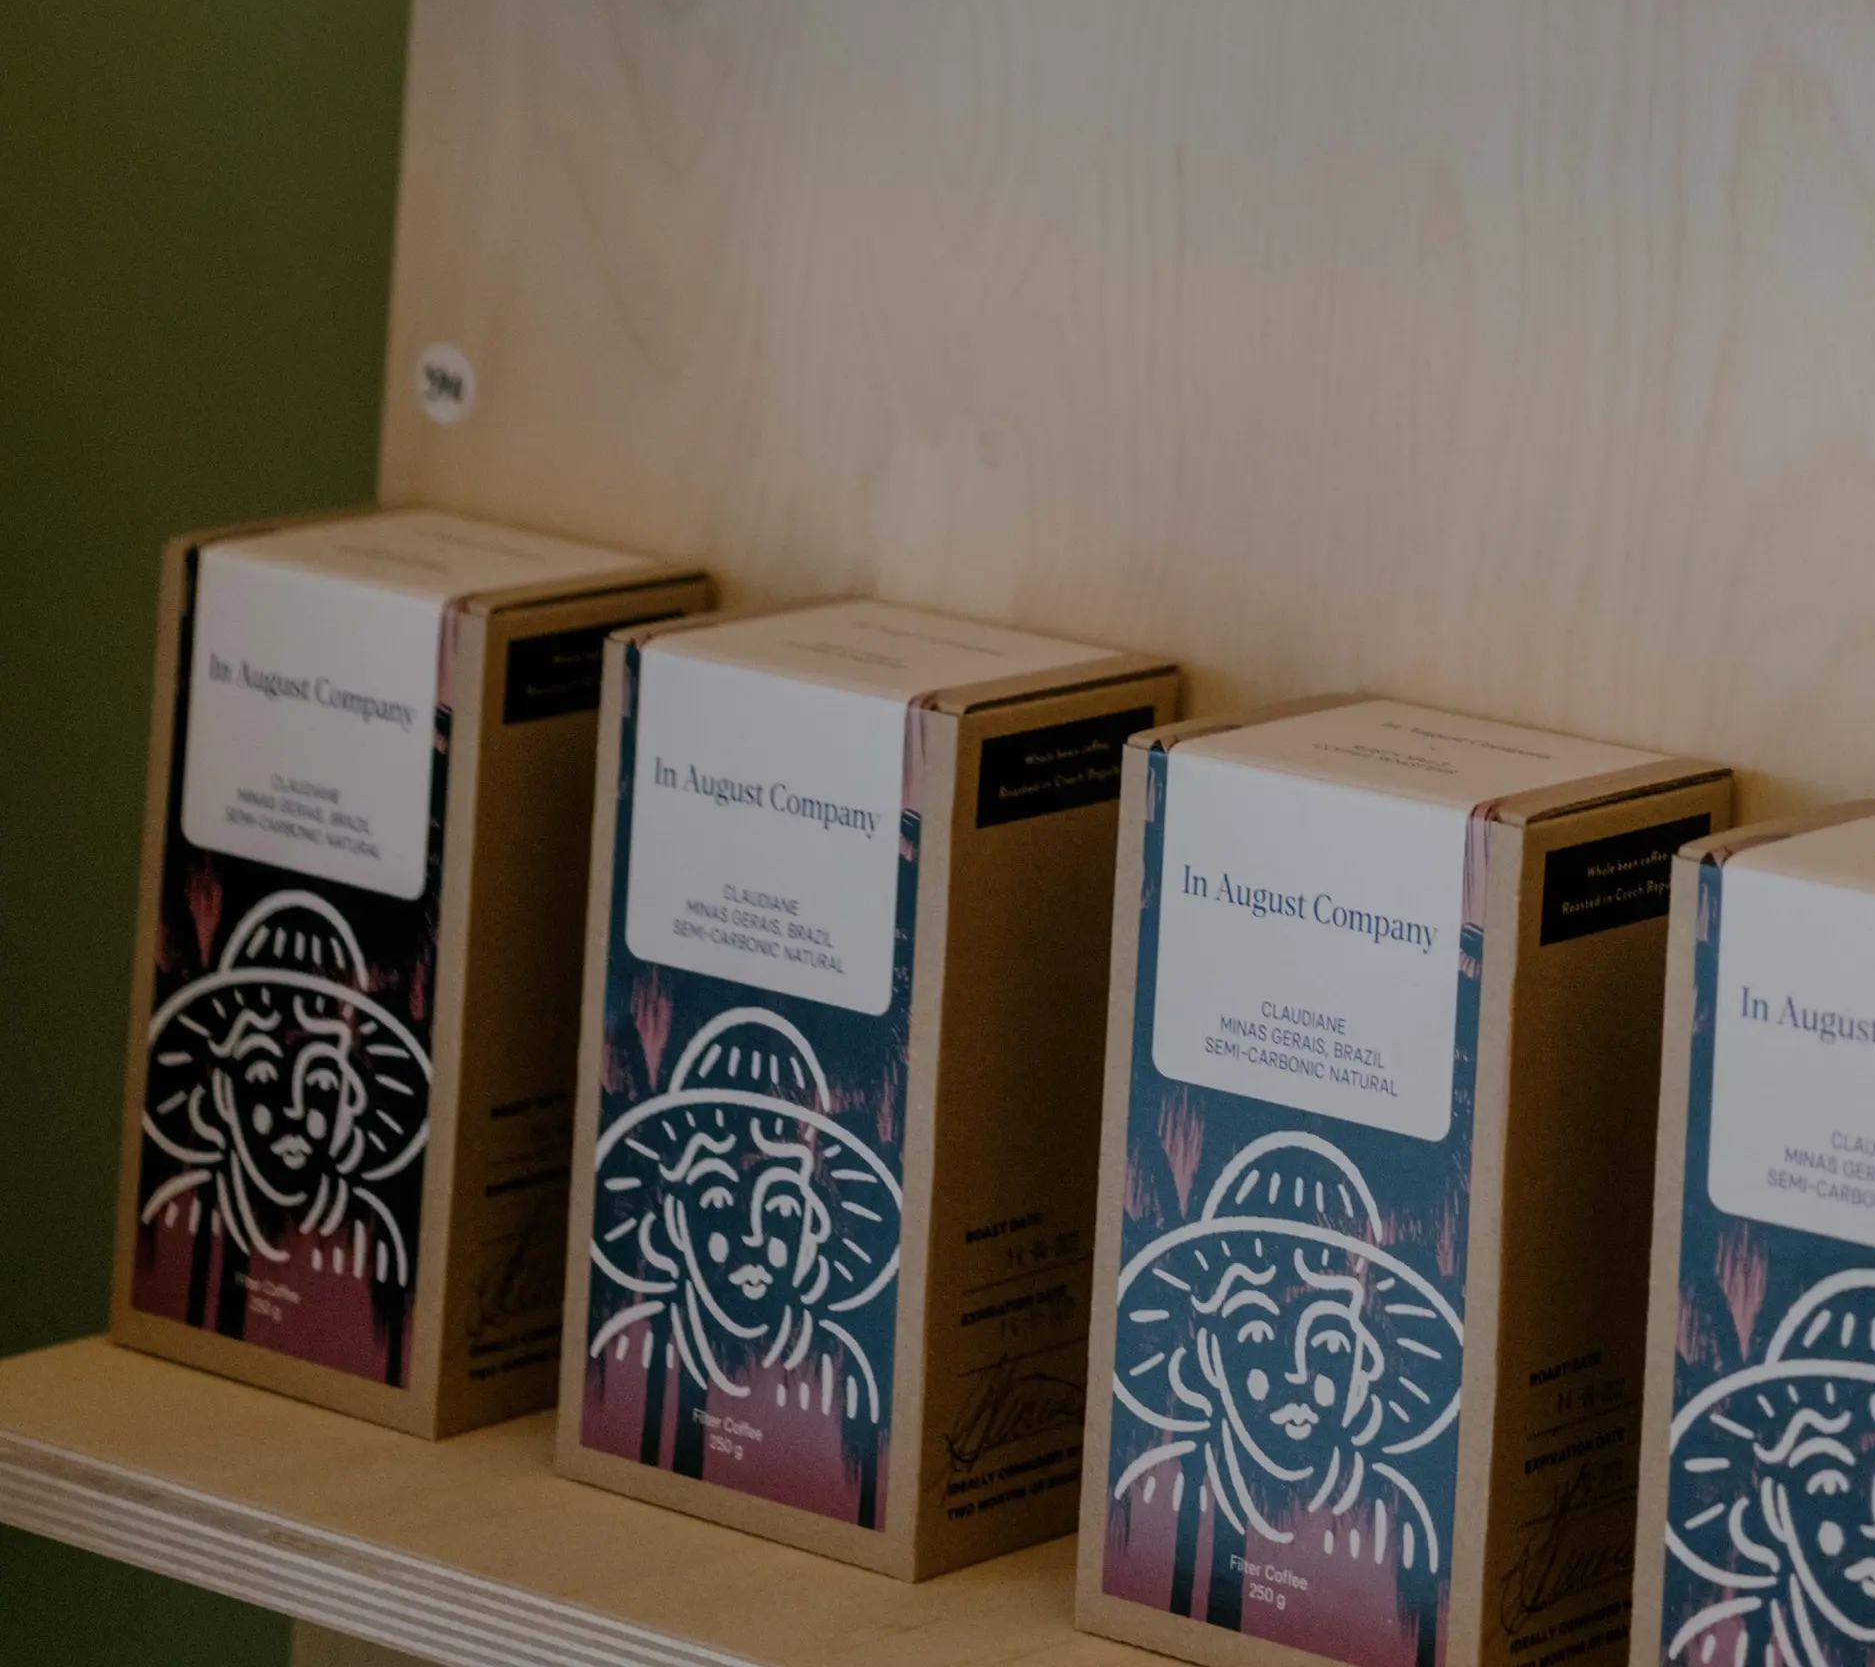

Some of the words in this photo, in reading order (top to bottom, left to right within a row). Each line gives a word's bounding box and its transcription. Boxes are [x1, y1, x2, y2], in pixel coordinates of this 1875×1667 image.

[210, 651, 232, 683] In
[237, 658, 311, 704] August
[313, 676, 417, 734] Company
[654, 755, 678, 789] In
[682, 763, 765, 808] August
[769, 782, 881, 839] Company
[722, 883, 800, 917] CLAUDIANE
[1181, 863, 1208, 898] In
[1215, 872, 1307, 920] August
[1313, 893, 1439, 955] Company
[672, 918, 780, 959] SEMI-CARBONIC
[783, 947, 845, 975] NATURAL
[685, 899, 728, 924] MINAS
[787, 922, 834, 949] BRAZIL
[1260, 999, 1347, 1036] CLAUDIANE
[1739, 984, 1770, 1024] In
[1219, 1014, 1268, 1042] MINAS
[1334, 1041, 1386, 1070] BRAZIL
[1203, 1035, 1325, 1080] SEMI-CARBONIC
[1329, 1068, 1399, 1098] NATURAL
[1783, 1146, 1838, 1177] MINAS
[708, 1433, 733, 1454] 250
[1229, 1553, 1262, 1578] Filter
[1264, 1564, 1309, 1591] Coffee
[1249, 1582, 1275, 1603] 250
[1276, 1594, 1287, 1611] g
